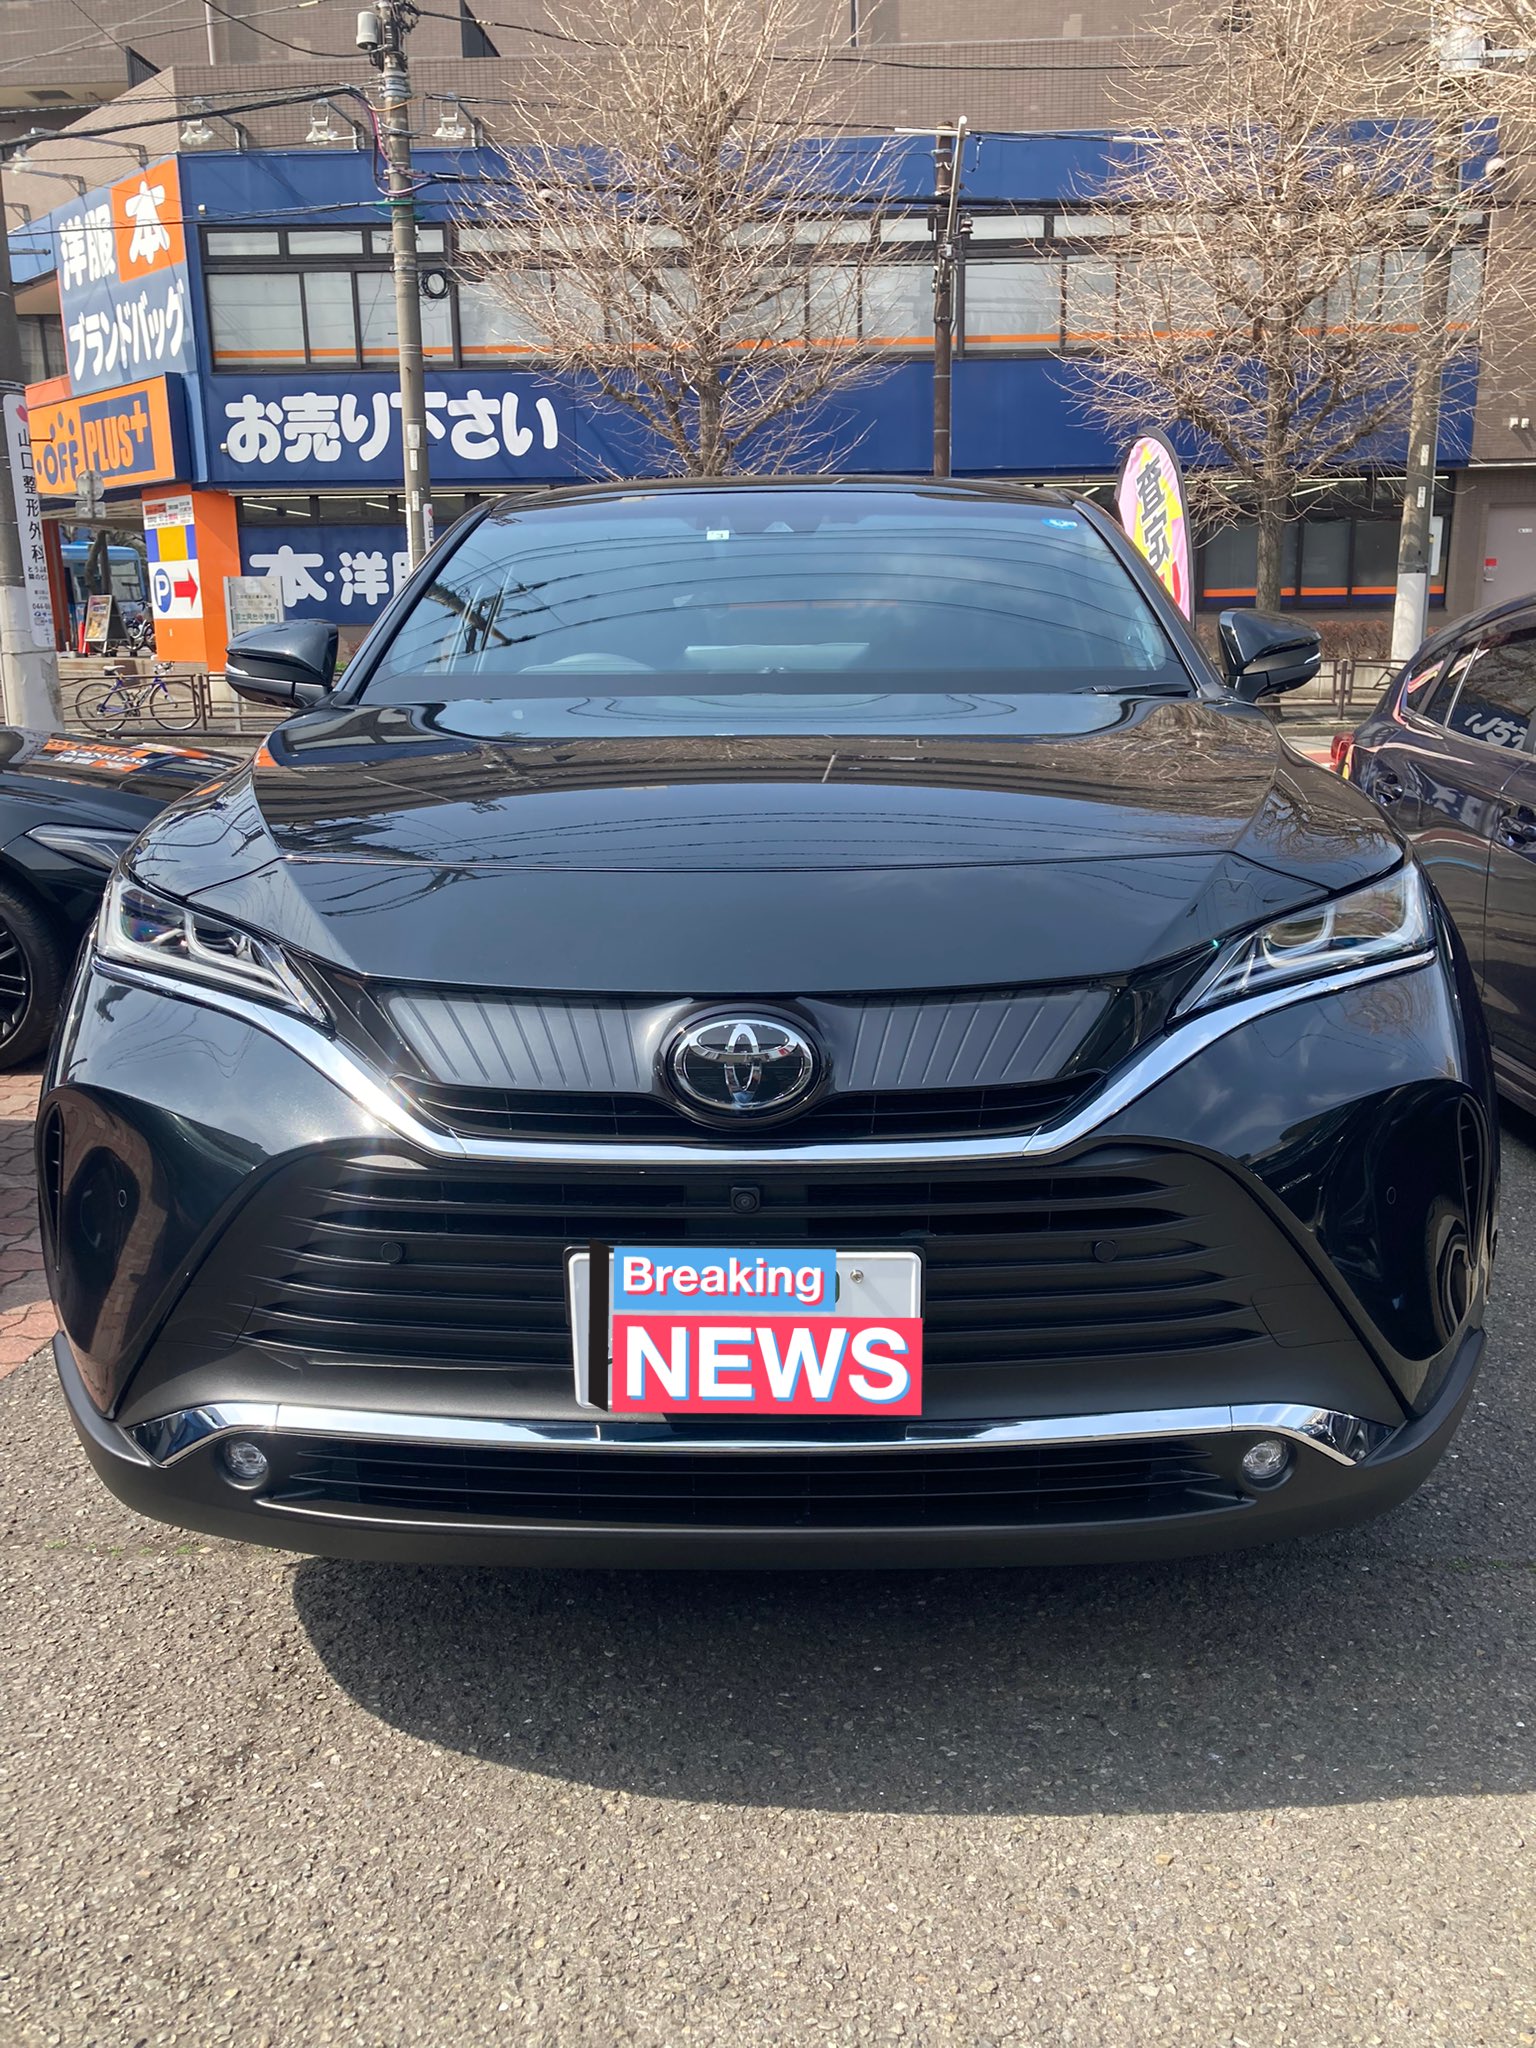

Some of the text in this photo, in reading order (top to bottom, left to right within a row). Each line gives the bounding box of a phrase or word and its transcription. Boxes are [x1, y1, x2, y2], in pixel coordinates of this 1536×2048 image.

[59, 180, 171, 291] 洋服 本
[68, 278, 184, 381] ブランドバッグ
